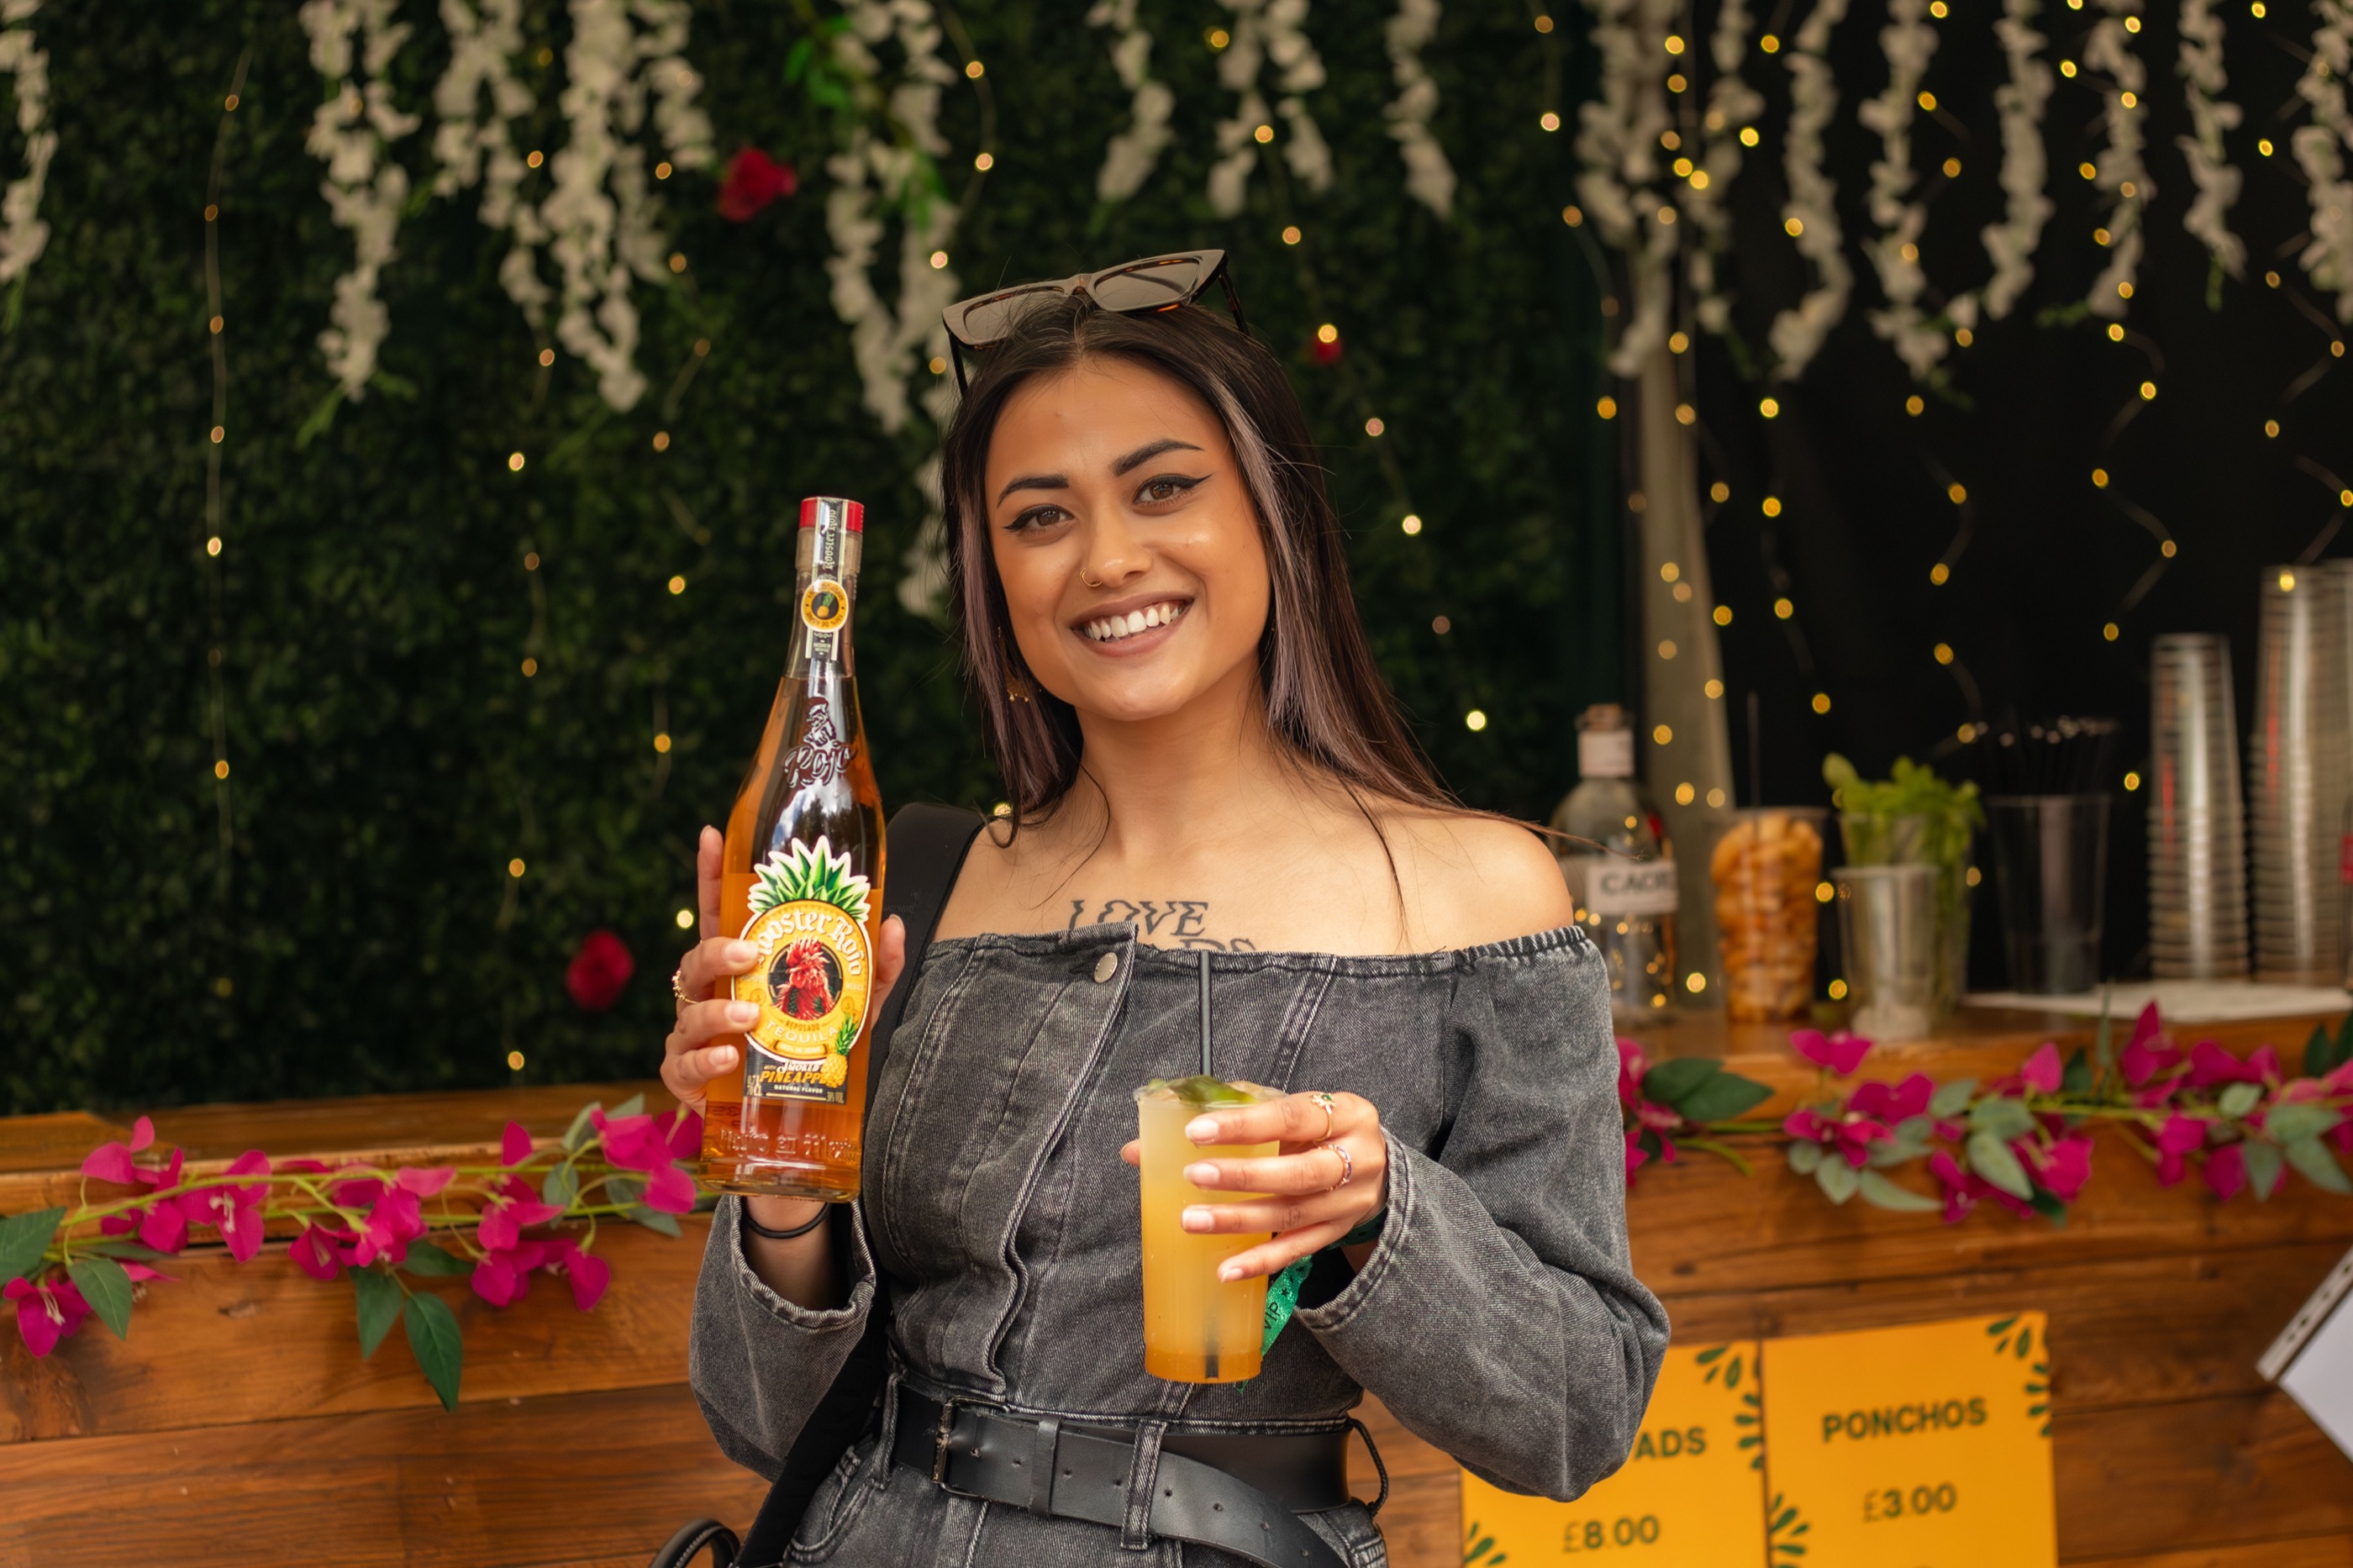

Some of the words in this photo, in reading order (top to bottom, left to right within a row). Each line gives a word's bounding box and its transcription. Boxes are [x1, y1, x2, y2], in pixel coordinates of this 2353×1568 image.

[827, 915, 866, 976] Rojo
[766, 1019, 839, 1044] TEQUILA
[759, 1070, 828, 1085] PINEAPPL
[773, 1084, 800, 1092] NATURAL
[1264, 1302, 1280, 1329] VIP
[1822, 1397, 1987, 1444] PONCHOS
[1634, 1426, 1708, 1461] ADS
[1862, 1482, 1958, 1523] £3.00
[1563, 1515, 1661, 1555] £8.00
